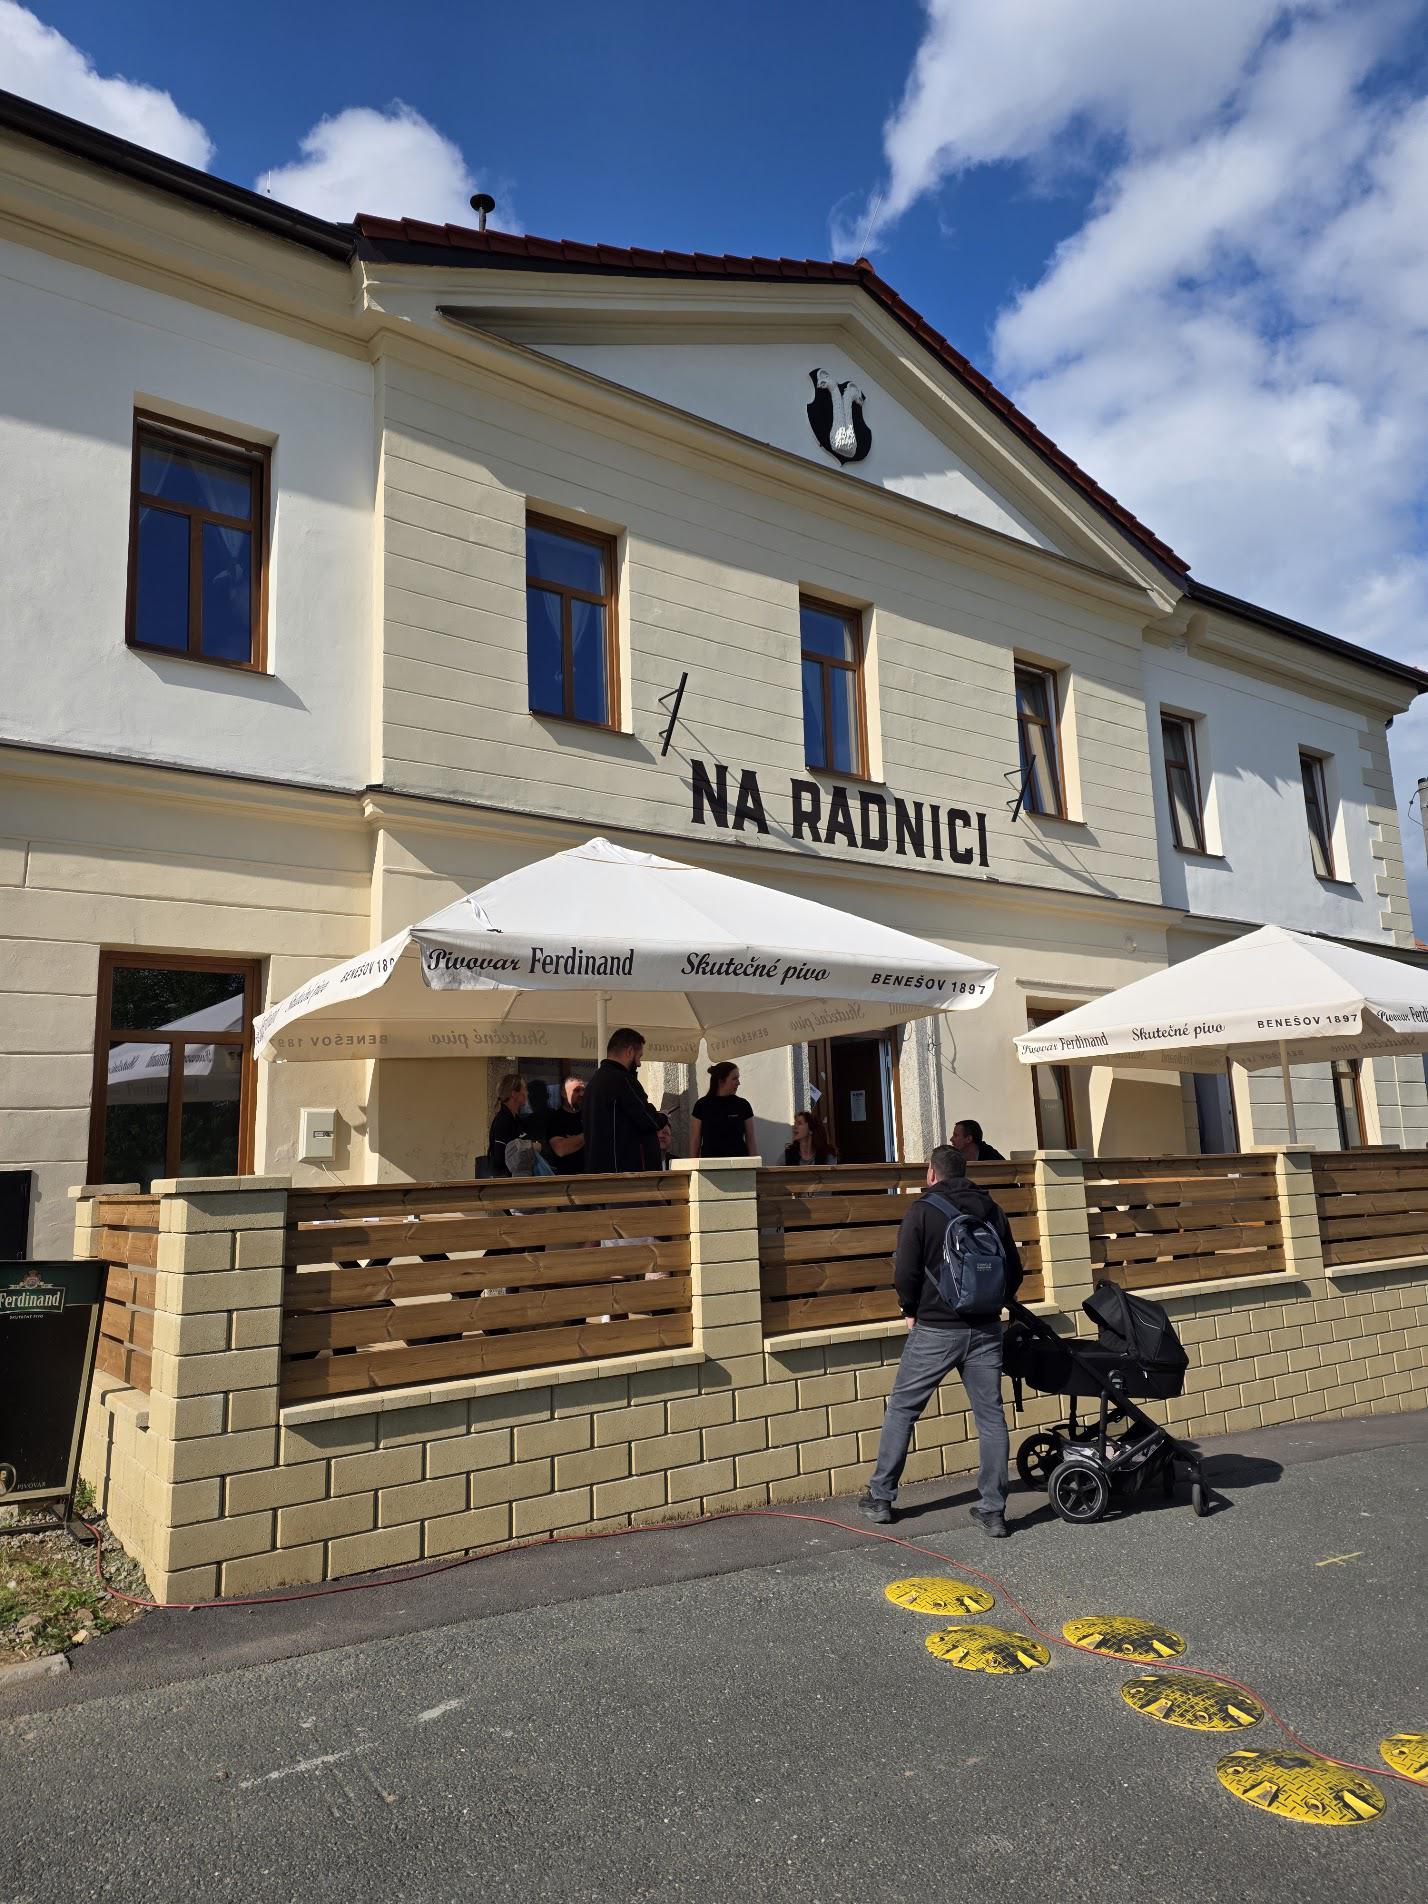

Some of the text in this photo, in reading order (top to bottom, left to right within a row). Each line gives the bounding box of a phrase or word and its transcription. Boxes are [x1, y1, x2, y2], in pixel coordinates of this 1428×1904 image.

[690, 758, 989, 867] NA RADNICI
[427, 946, 986, 995] Pivovar Ferdinand Skutečné pivo BENEŠOV 1897
[1059, 1032, 1109, 1051] Ferdinand
[1131, 1022, 1189, 1042] Skutečné
[1193, 1022, 1226, 1039] pivo
[1257, 1015, 1321, 1029] BENEŠOV
[1326, 1013, 1358, 1024] 1897
[0, 1291, 60, 1308] Ferdinand
